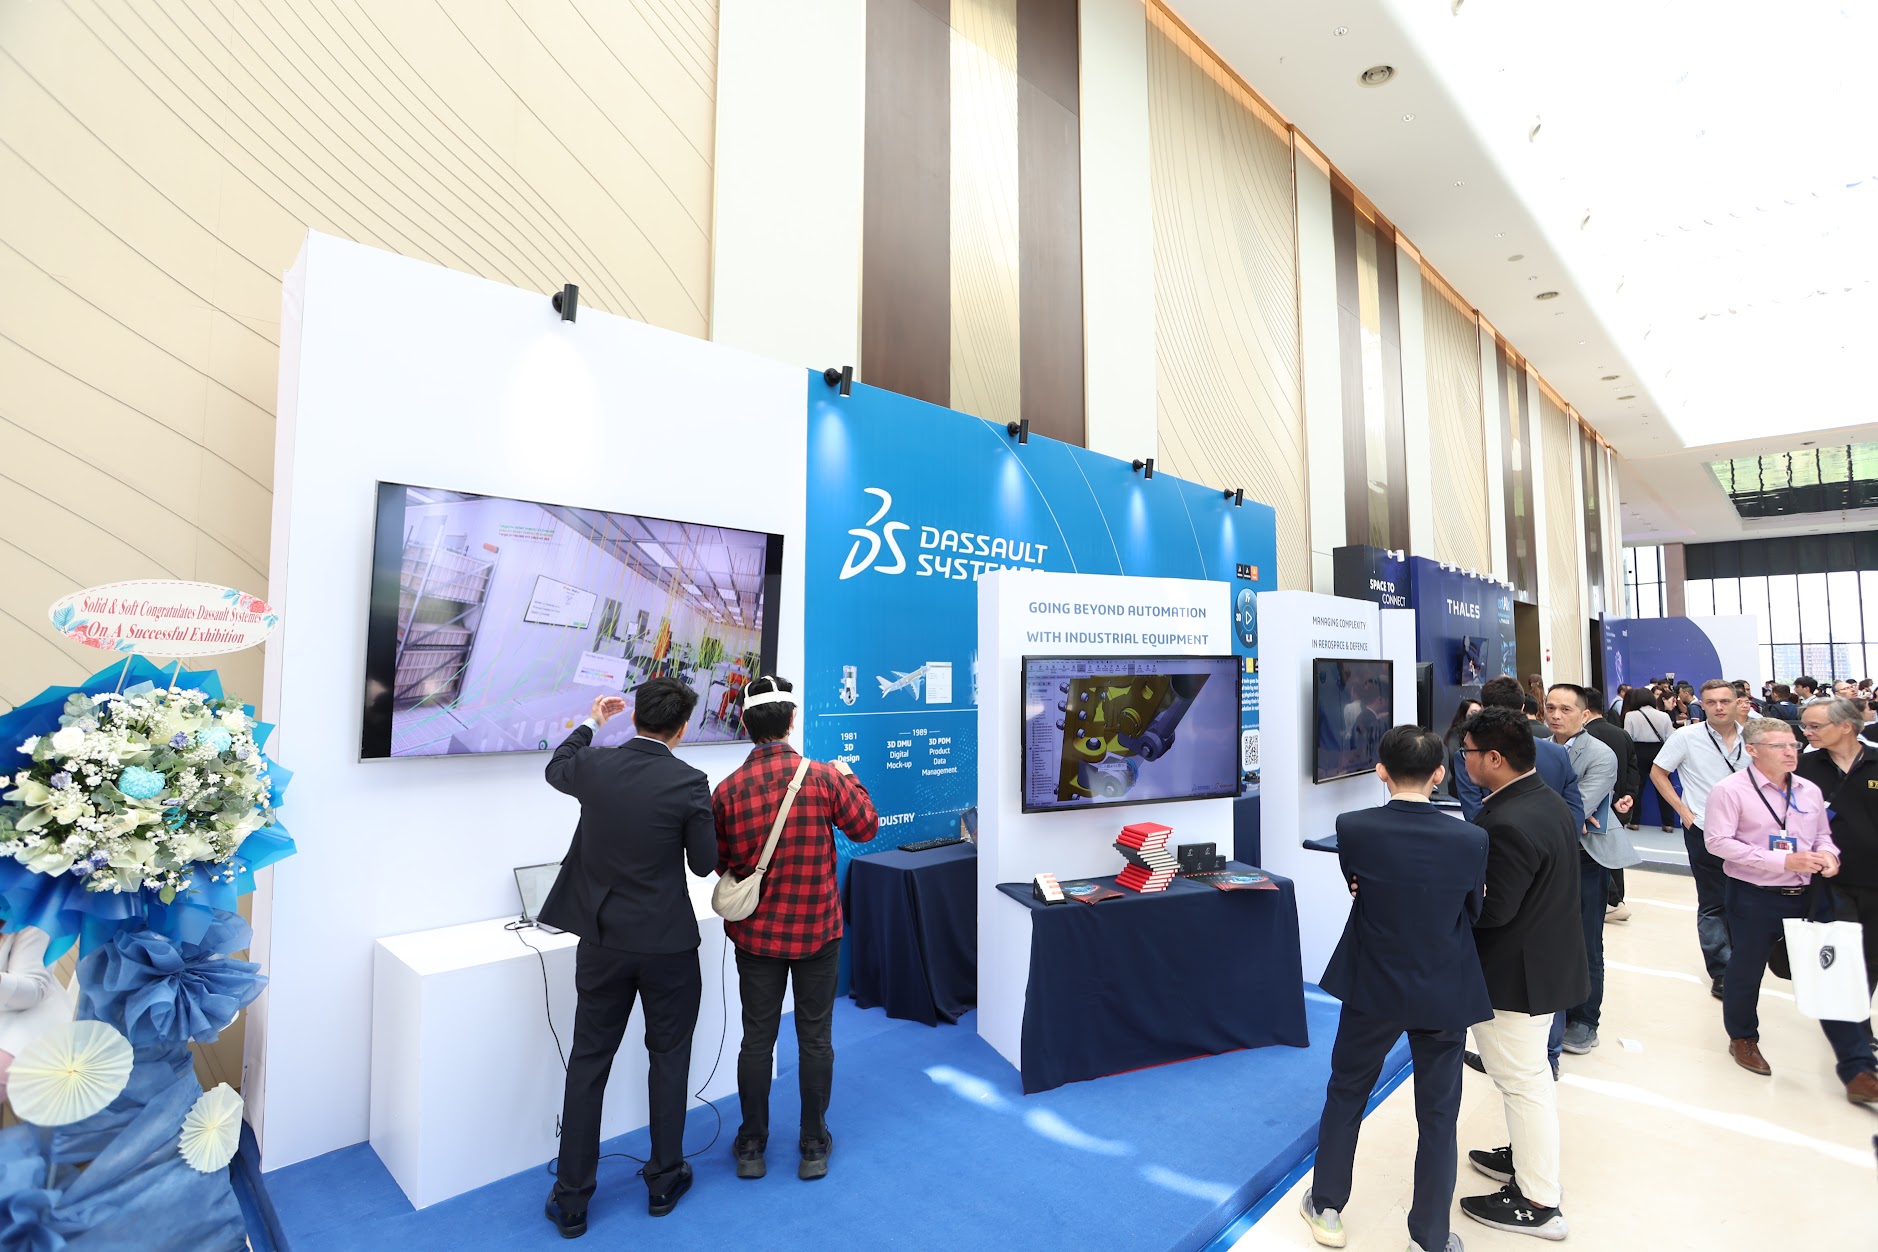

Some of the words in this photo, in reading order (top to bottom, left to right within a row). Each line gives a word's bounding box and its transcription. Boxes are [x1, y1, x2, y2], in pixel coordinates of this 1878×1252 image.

[920, 526, 1048, 563] DASSAULT
[916, 554, 1044, 581] SYST
[1369, 578, 1386, 592] SPACE
[1387, 582, 1395, 593] TO
[1382, 593, 1406, 607] CONNECT
[81, 596, 108, 614] Solid
[108, 599, 118, 615] &
[118, 599, 139, 616] Soft
[139, 600, 195, 622] Congratulates
[196, 604, 230, 622] Dassault
[1029, 601, 1071, 614] GOING
[1074, 603, 1125, 616] BEYOND
[1128, 605, 1207, 618] AUTOMATION
[1446, 598, 1480, 619] THALES
[1312, 616, 1339, 628] MANAGING
[1340, 618, 1366, 630] COMPLEXITY
[87, 621, 108, 638] On
[110, 622, 122, 638] A
[126, 623, 189, 641] Successful
[189, 626, 245, 644] Exhibition
[1027, 631, 1061, 643] WITH
[1065, 632, 1139, 644] INDUSTRIAL
[1142, 633, 1208, 647] EQUIPMENT
[1311, 639, 1317, 649] IN
[1318, 639, 1345, 650] AEROSPACE
[1345, 642, 1349, 650] &
[1349, 642, 1368, 651] DEFENCE
[840, 732, 857, 740] 1981
[912, 728, 928, 737] 1989
[844, 743, 854, 751] 3D
[887, 741, 896, 749] 3D
[897, 739, 912, 748] DMU
[928, 738, 937, 746] 3D
[937, 737, 951, 745] PDM
[889, 750, 909, 760] Digital
[929, 747, 951, 756] Product
[837, 754, 860, 763] Design
[933, 757, 946, 765] Data
[886, 761, 912, 769] Mock-up
[921, 766, 957, 776] Management
[878, 812, 915, 827] DUSTRY
